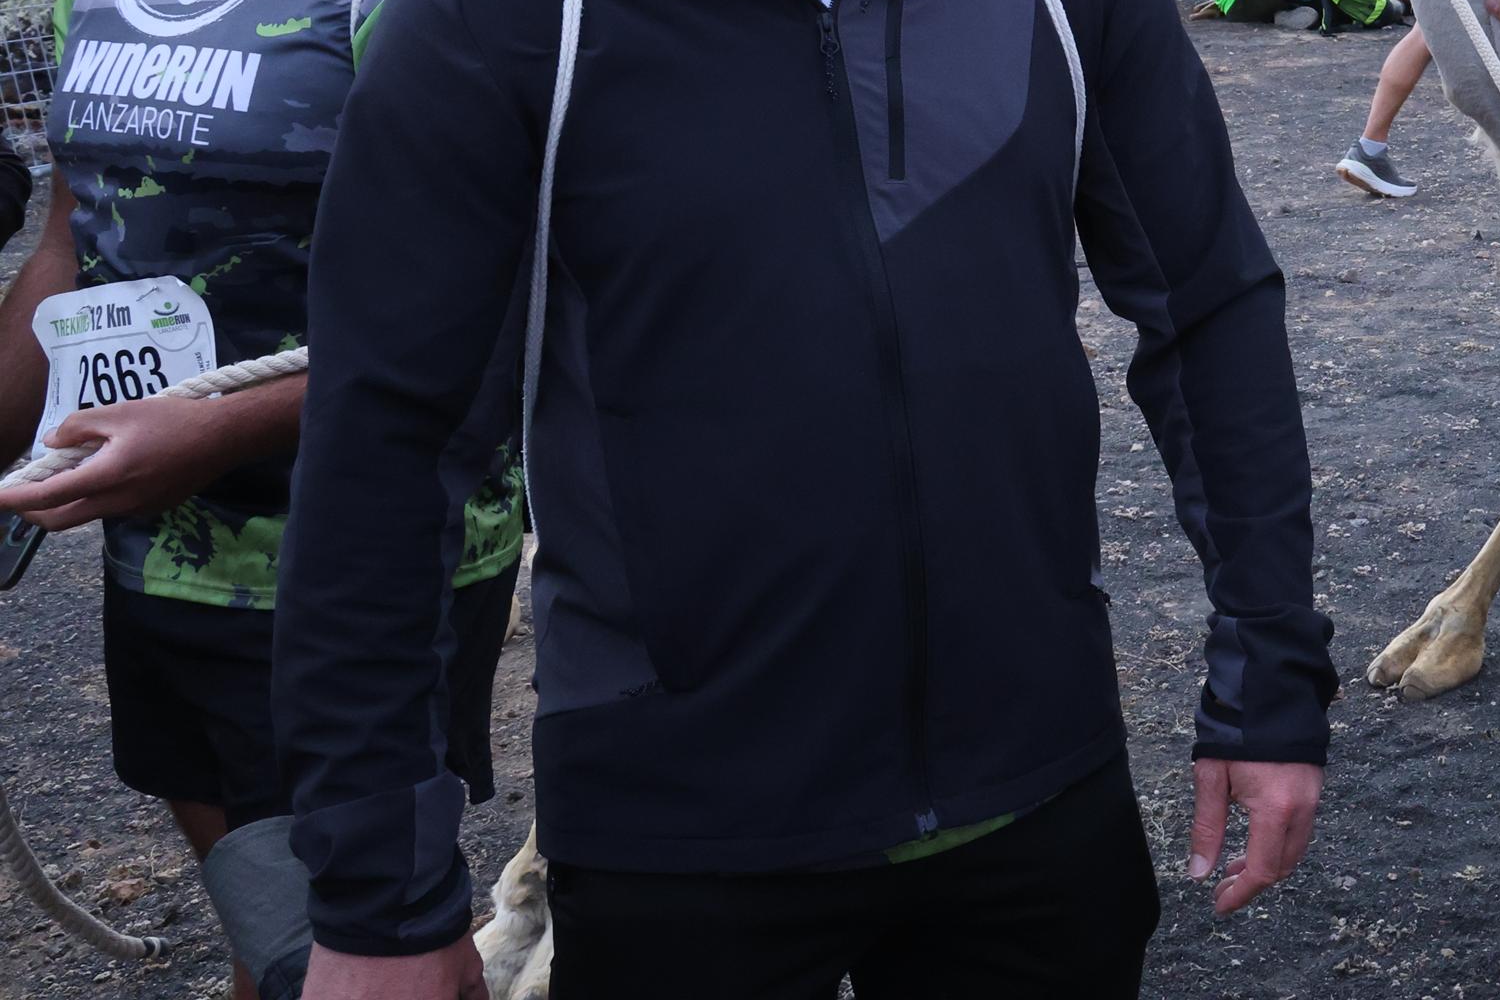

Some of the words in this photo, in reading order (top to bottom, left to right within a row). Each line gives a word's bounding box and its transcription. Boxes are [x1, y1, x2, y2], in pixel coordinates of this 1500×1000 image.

[68, 99, 214, 146] LANZAROTE
[91, 305, 103, 332] 12
[107, 303, 132, 329] Km
[78, 346, 169, 411] 2663
